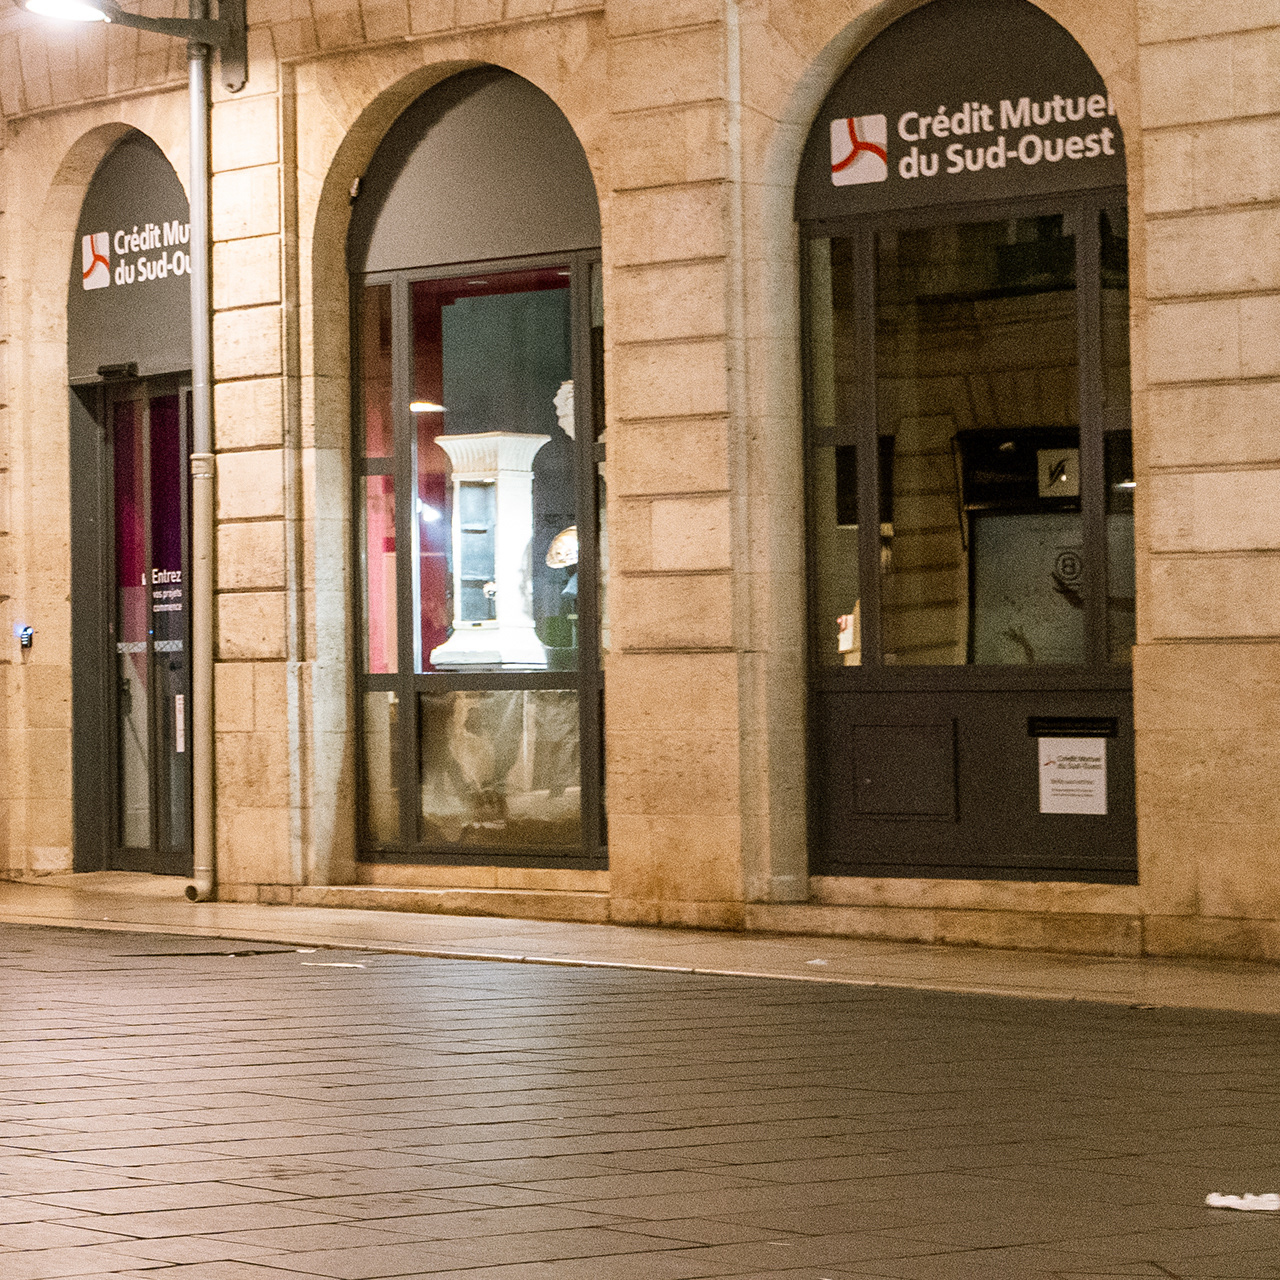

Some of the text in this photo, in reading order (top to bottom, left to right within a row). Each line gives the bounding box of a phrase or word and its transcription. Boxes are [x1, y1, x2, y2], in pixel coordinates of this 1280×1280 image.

[897, 101, 995, 142] Crédit
[898, 126, 1115, 180] du Sud-Ouest
[113, 223, 162, 255] Crédit
[115, 259, 135, 286] du
[151, 568, 182, 584] Entrez
